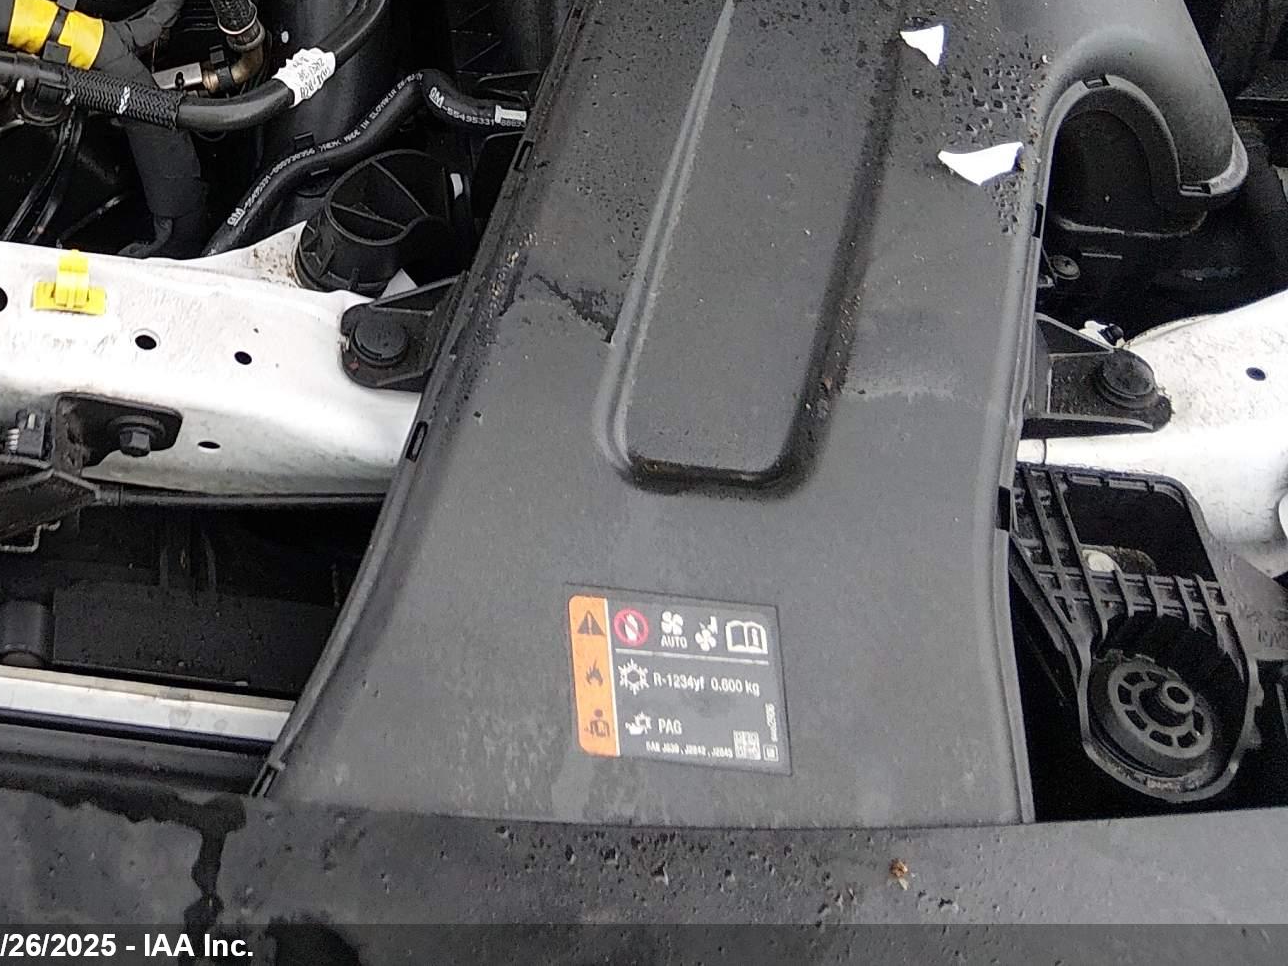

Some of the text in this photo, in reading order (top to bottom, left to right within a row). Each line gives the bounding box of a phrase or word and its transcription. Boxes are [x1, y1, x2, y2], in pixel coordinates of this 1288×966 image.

[660, 635, 688, 649] AUTO
[653, 672, 705, 693] R-1234yf
[744, 679, 761, 697] kg
[658, 718, 683, 735] PAG
